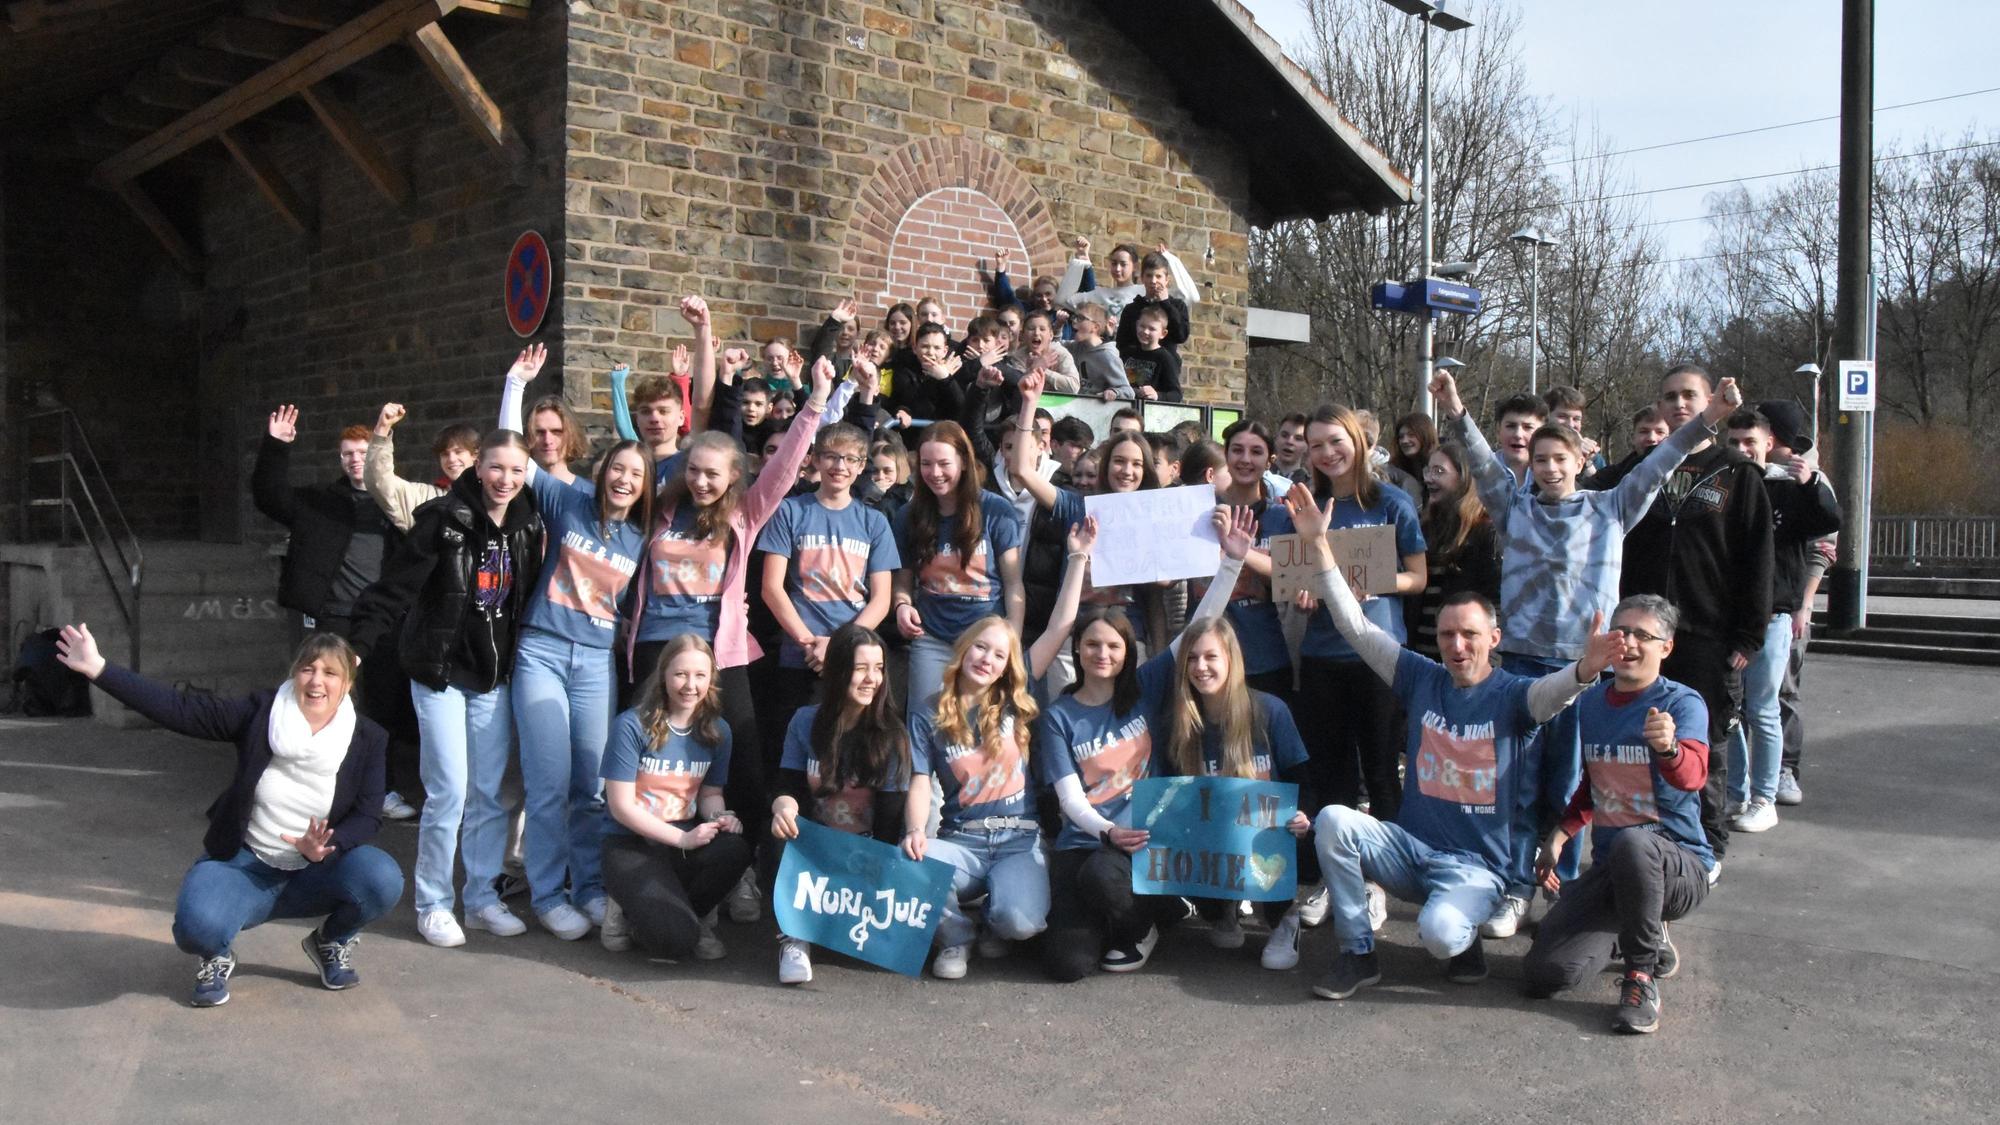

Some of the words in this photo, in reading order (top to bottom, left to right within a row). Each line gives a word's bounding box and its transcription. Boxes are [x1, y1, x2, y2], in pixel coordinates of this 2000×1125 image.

[1850, 373, 1865, 392] P
[594, 546, 607, 561] &
[1278, 539, 1312, 567] JUL
[1106, 731, 1119, 748] &
[1603, 744, 1611, 763] &
[1617, 745, 1651, 764] NURI
[674, 760, 685, 776] &
[1200, 787, 1213, 823] I
[1234, 792, 1281, 831] AM
[1146, 847, 1246, 892] HOME
